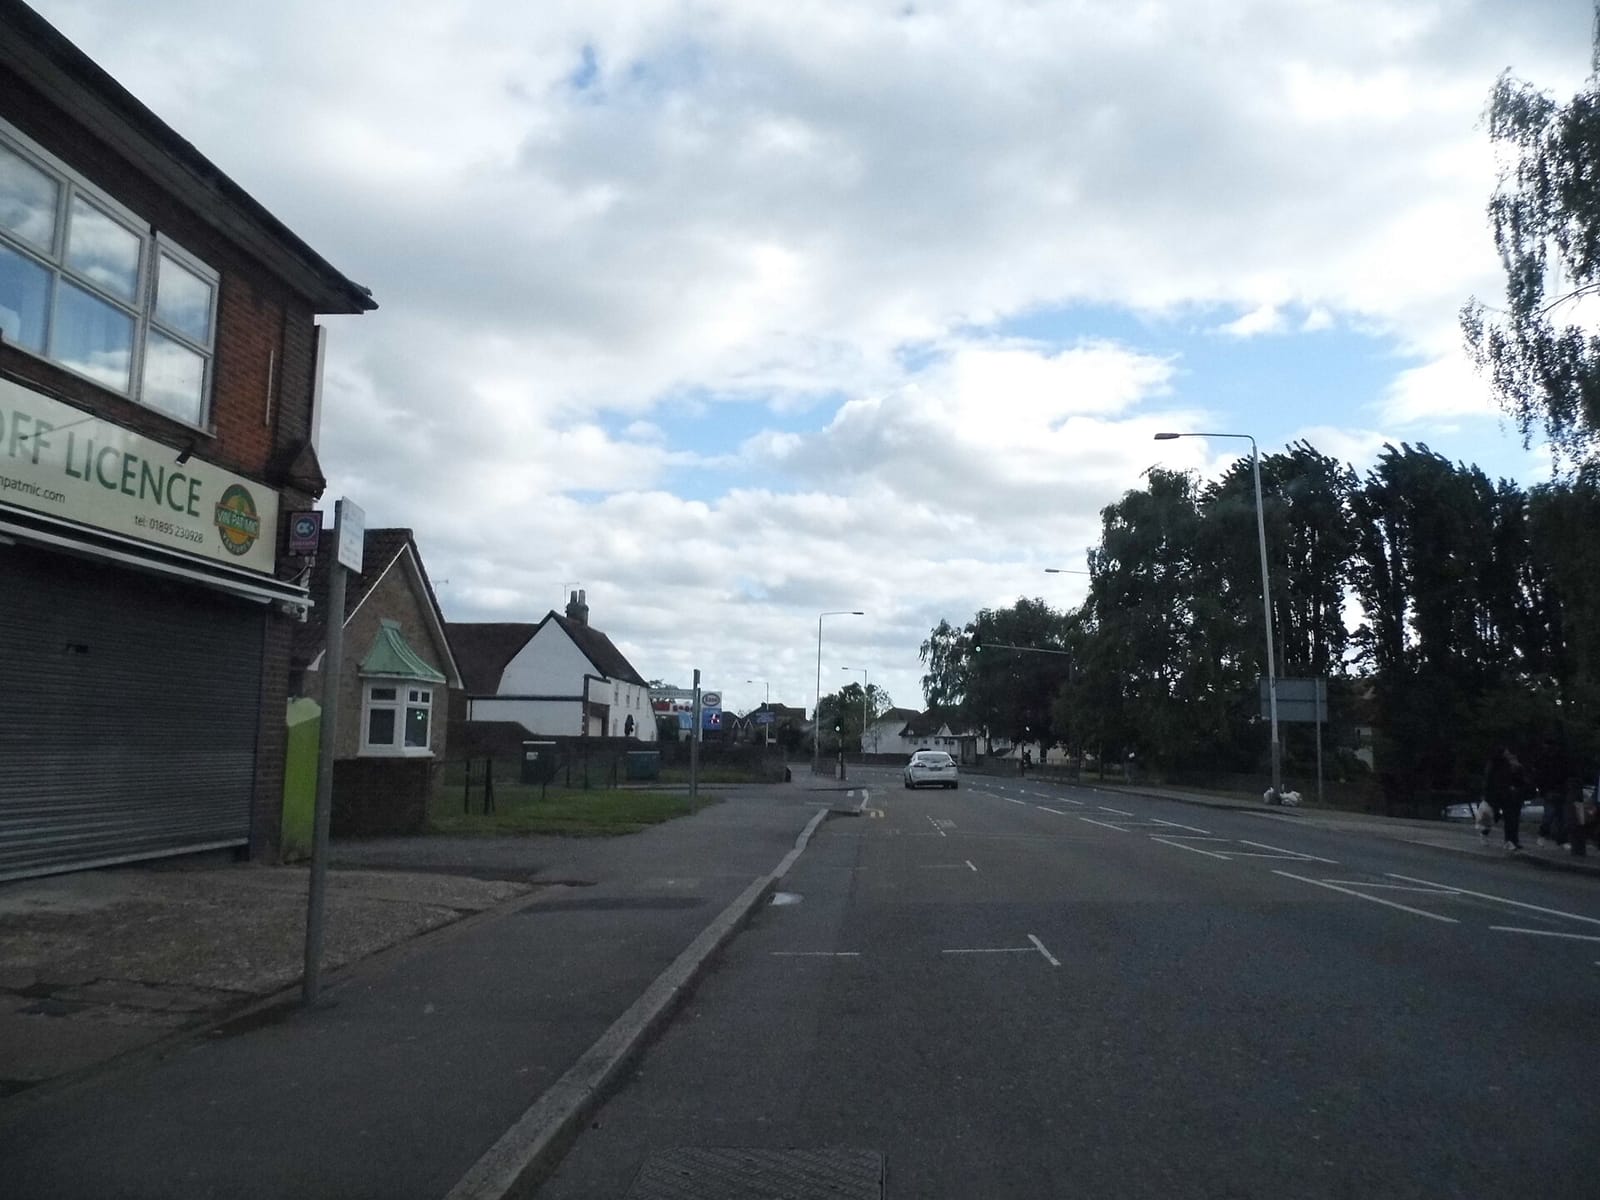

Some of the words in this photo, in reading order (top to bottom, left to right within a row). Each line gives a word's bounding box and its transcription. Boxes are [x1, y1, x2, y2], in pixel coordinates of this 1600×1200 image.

[0, 407, 54, 465] FF
[65, 431, 202, 517] LICENCE
[149, 518, 174, 535] 01895
